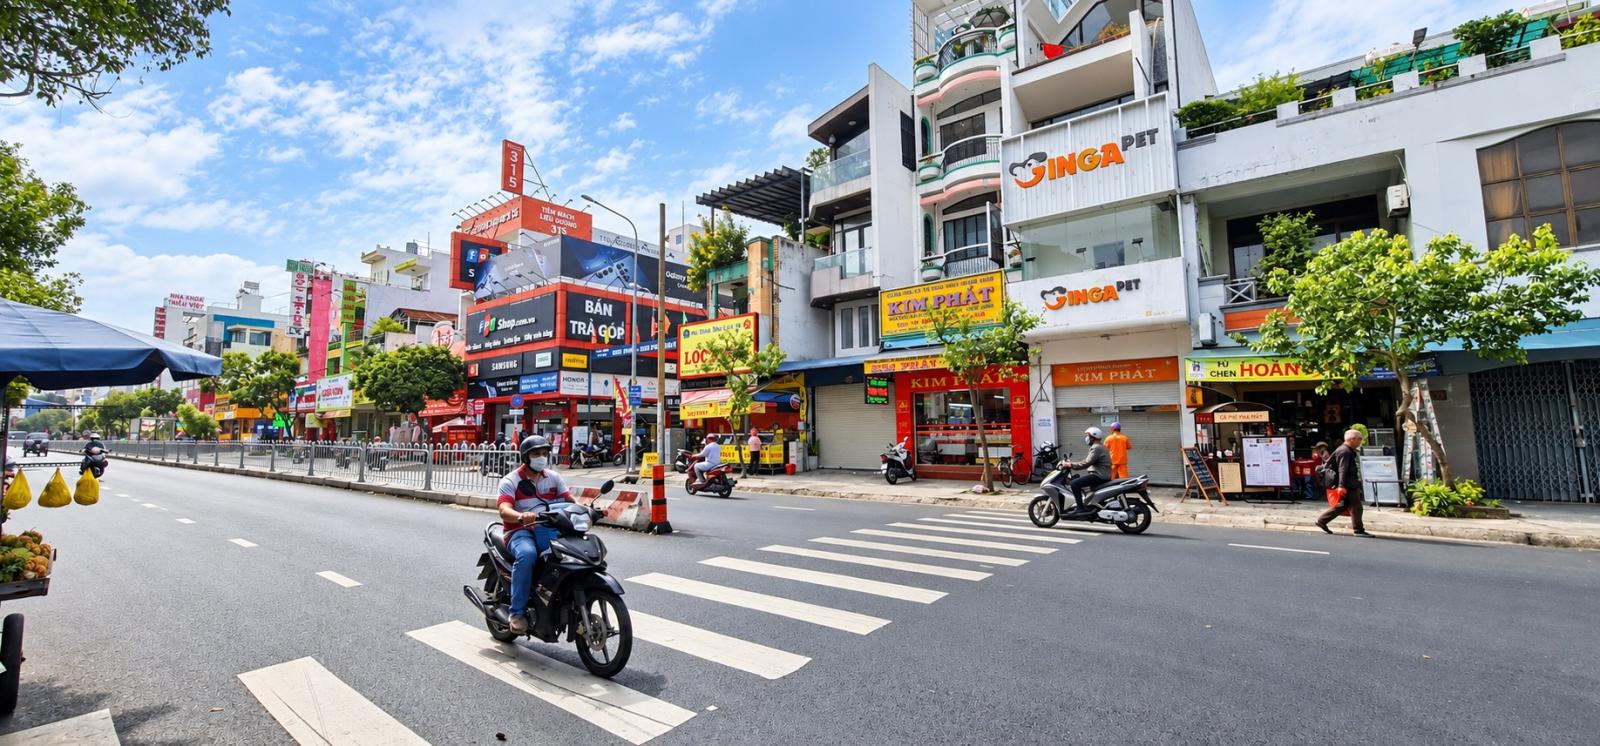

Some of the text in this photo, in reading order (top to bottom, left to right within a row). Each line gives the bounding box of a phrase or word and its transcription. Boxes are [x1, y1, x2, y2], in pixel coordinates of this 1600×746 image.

[1121, 128, 1159, 152] PET
[1116, 278, 1142, 292] PET
[585, 298, 613, 317] BÁN
[888, 298, 929, 316] KIM
[570, 318, 625, 339] TRÀ GÓP
[491, 359, 518, 371] SAMSUNG
[911, 378, 946, 388] KIM
[1074, 373, 1104, 382] KIM
